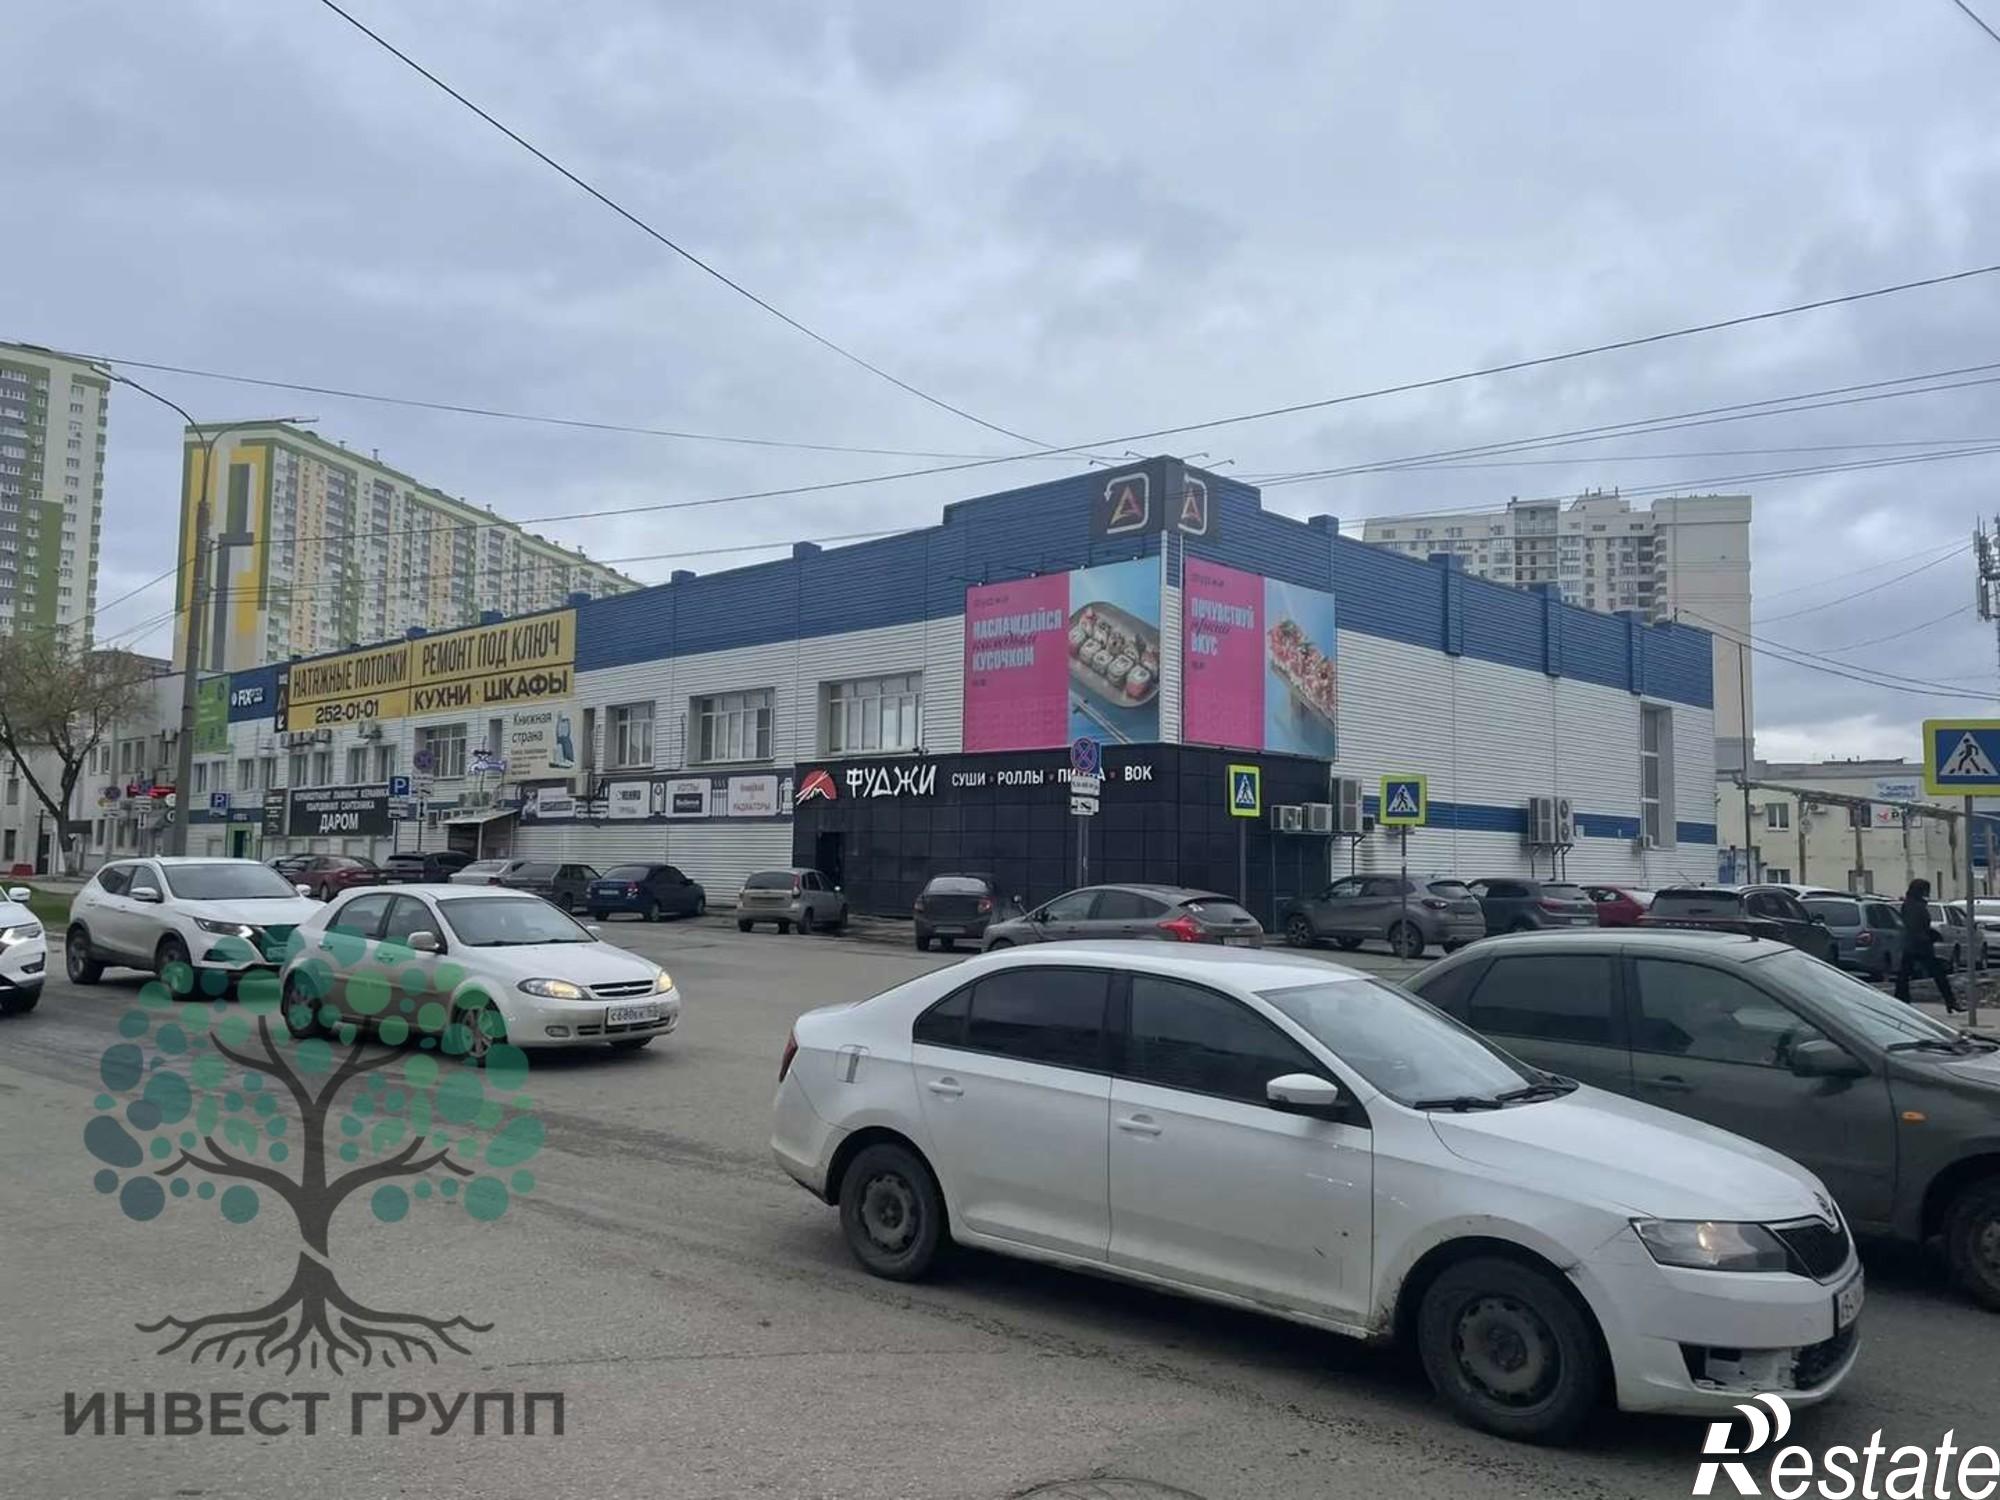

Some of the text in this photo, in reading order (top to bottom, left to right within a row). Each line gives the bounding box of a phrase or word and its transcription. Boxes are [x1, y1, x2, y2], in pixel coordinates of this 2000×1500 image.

[973, 608, 1062, 639] НАСЛАЖДАЙСЯ
[422, 619, 560, 677] РЕМОНТ ПОД КЛЮЧ
[973, 646, 1034, 672] КУСОЧКОМ
[293, 648, 407, 698] НАТЯЖНЫЕ ПОТОЛКИ
[414, 670, 568, 711] КУХНИ ШКАФЫ
[315, 700, 379, 724] 252-01-01
[513, 712, 551, 725] Книжная
[512, 731, 543, 745] страна
[846, 764, 937, 798] ФУДЖИ
[952, 773, 985, 787] СУШИ
[997, 769, 1044, 785] РОЛЛЫ
[1124, 765, 1153, 781] ВОК
[319, 813, 359, 833] ДАРОМ
